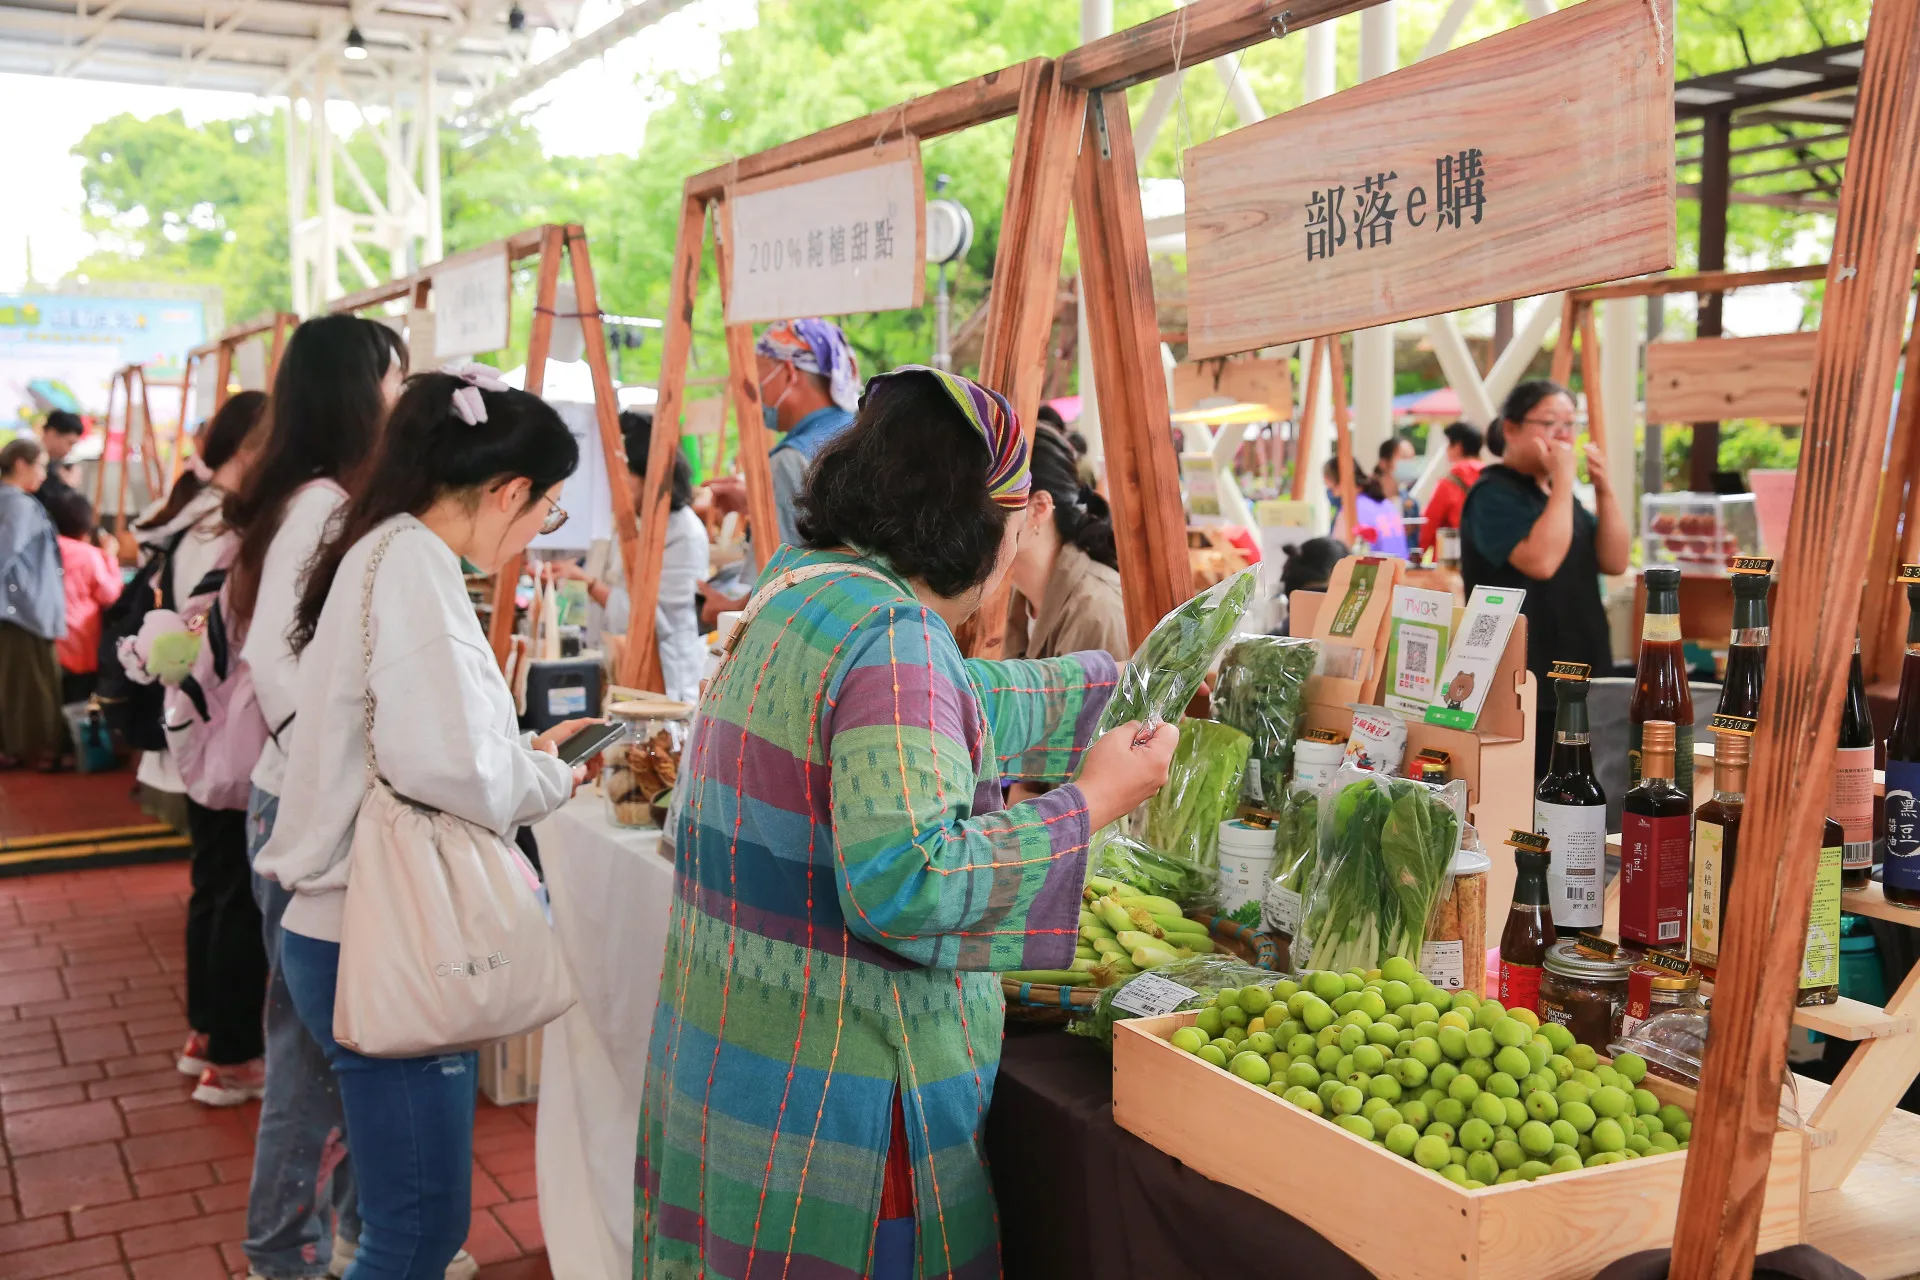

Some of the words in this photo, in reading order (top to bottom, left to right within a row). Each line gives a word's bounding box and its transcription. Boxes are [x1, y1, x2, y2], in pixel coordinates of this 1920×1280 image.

[1304, 148, 1487, 262] 部落e購
[1887, 817, 1898, 847] 醬油
[1898, 798, 1920, 844] 黑豆
[1632, 842, 1644, 872] 黑豆
[435, 950, 511, 977] CHANEL
[1547, 1006, 1573, 1020] Sucrose
